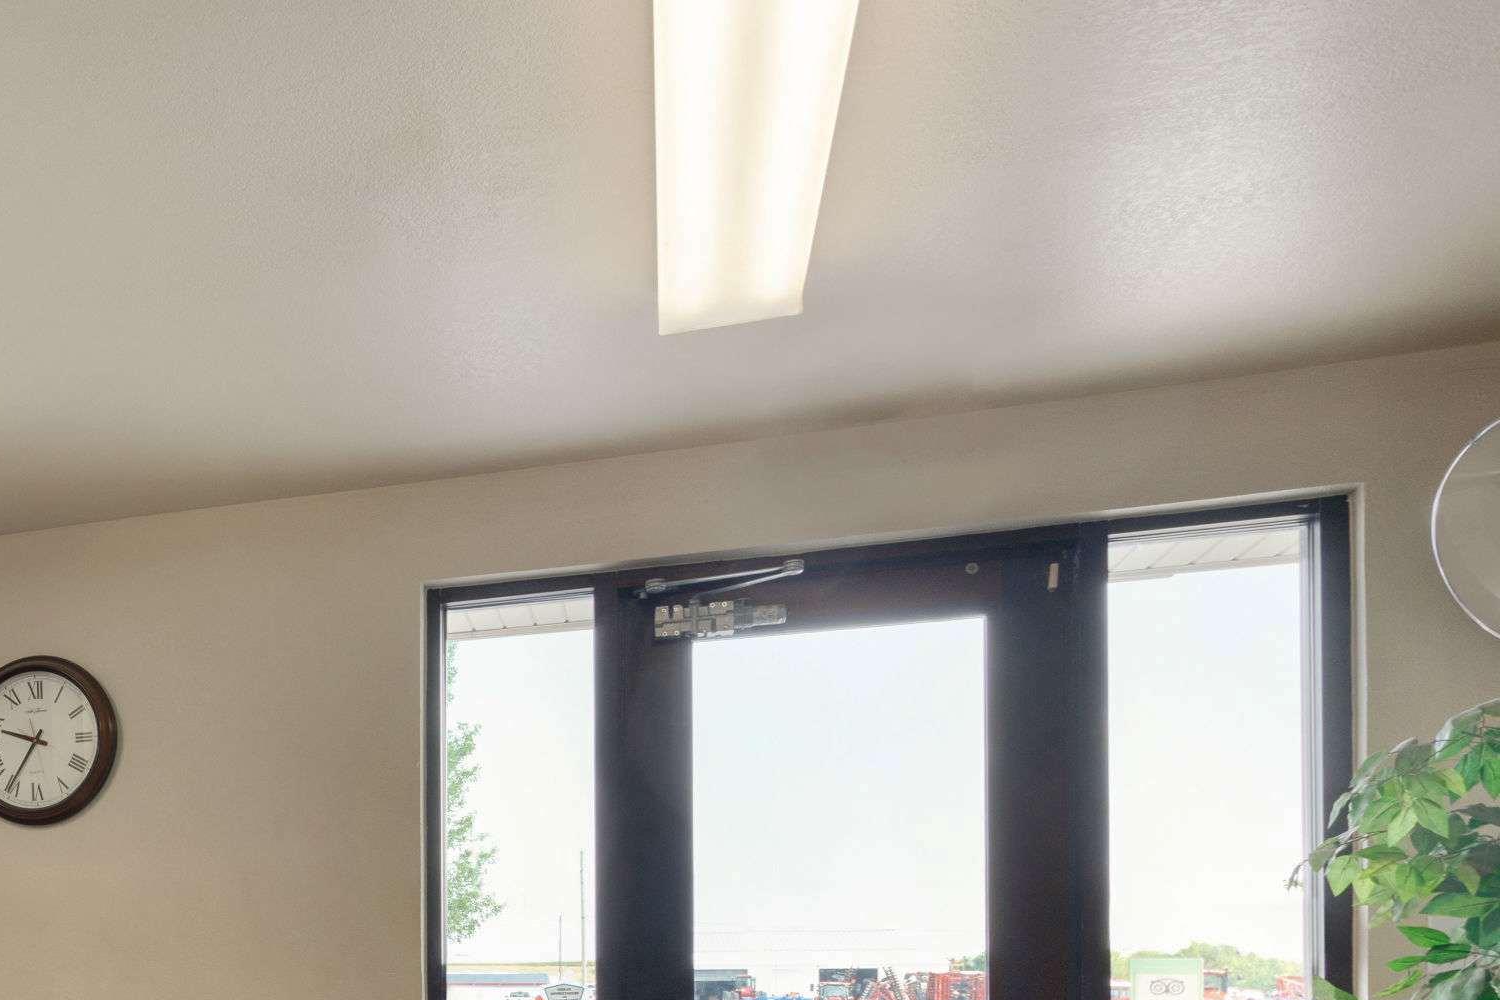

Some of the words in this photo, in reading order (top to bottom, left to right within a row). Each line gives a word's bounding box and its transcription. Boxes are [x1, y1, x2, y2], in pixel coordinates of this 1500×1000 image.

[27, 681, 44, 699] XII
[54, 681, 66, 703] I
[68, 704, 86, 719] II
[75, 732, 93, 743] III
[68, 753, 89, 773] IIII
